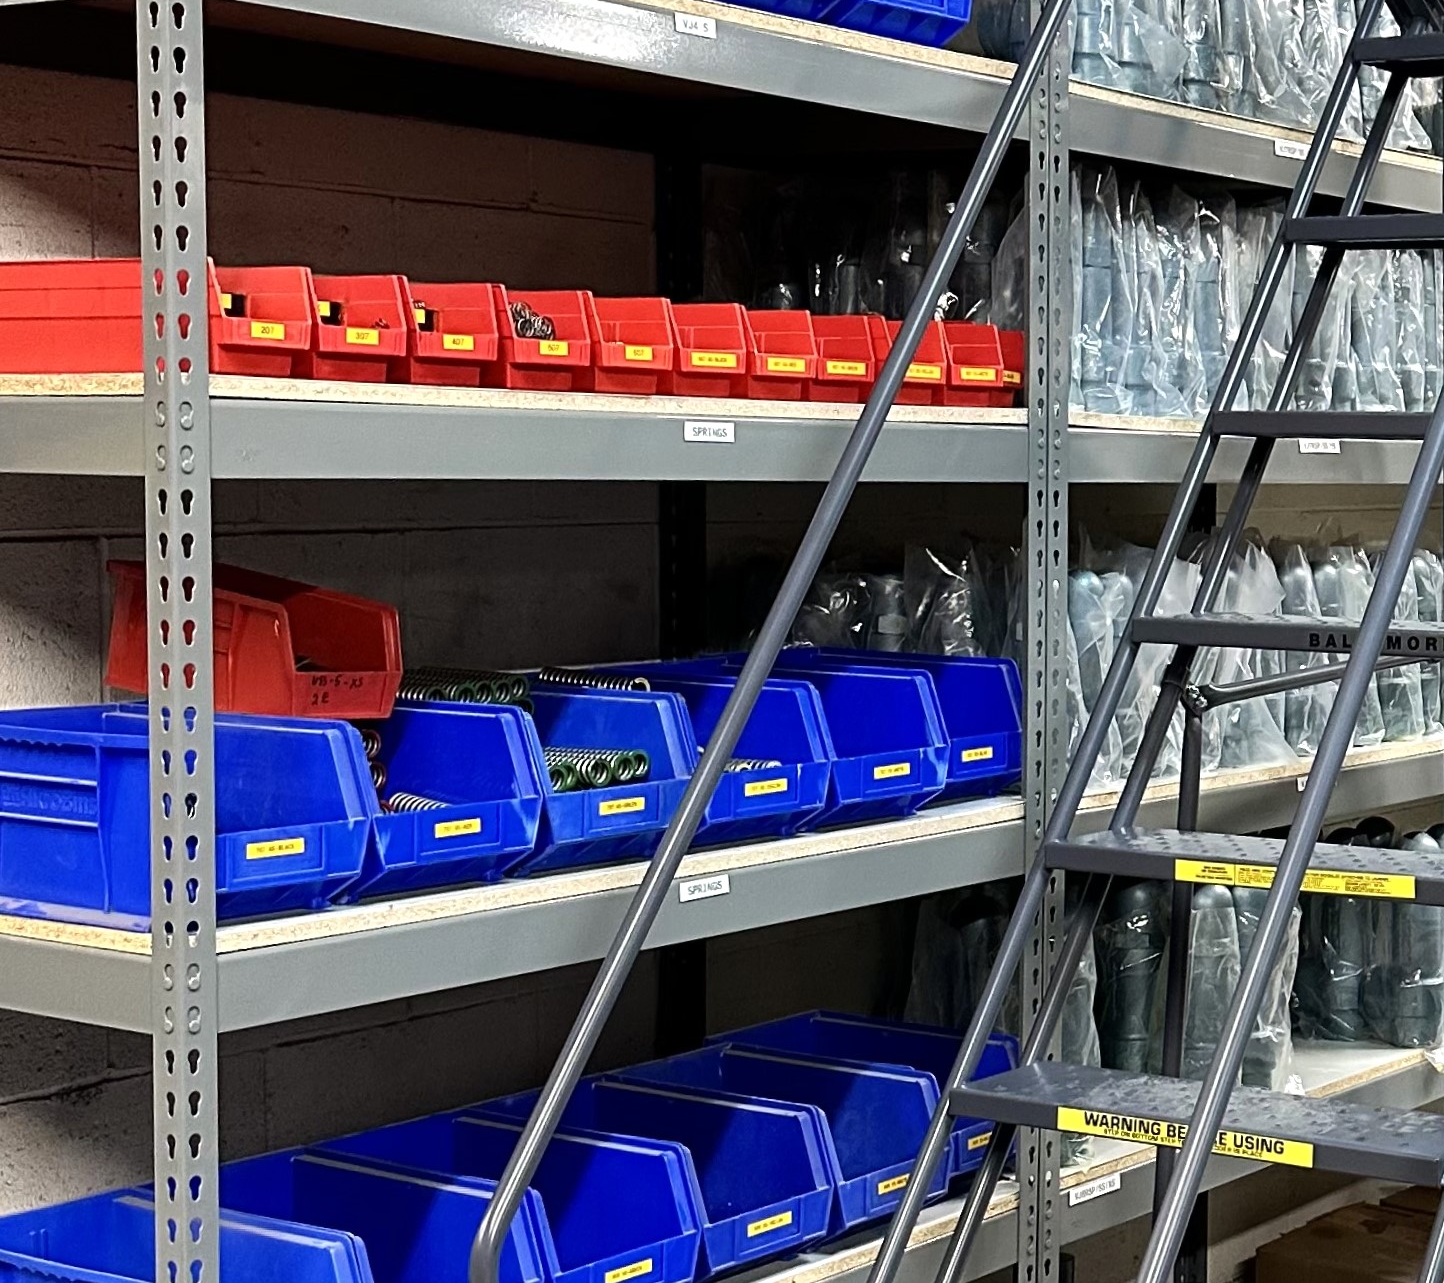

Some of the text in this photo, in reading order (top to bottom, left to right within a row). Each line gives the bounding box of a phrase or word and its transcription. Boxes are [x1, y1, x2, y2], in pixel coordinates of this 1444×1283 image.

[692, 425, 728, 439] SPRINGS
[687, 880, 722, 897] SPRINGS
[1084, 1111, 1285, 1155] WARNING BEE USING
